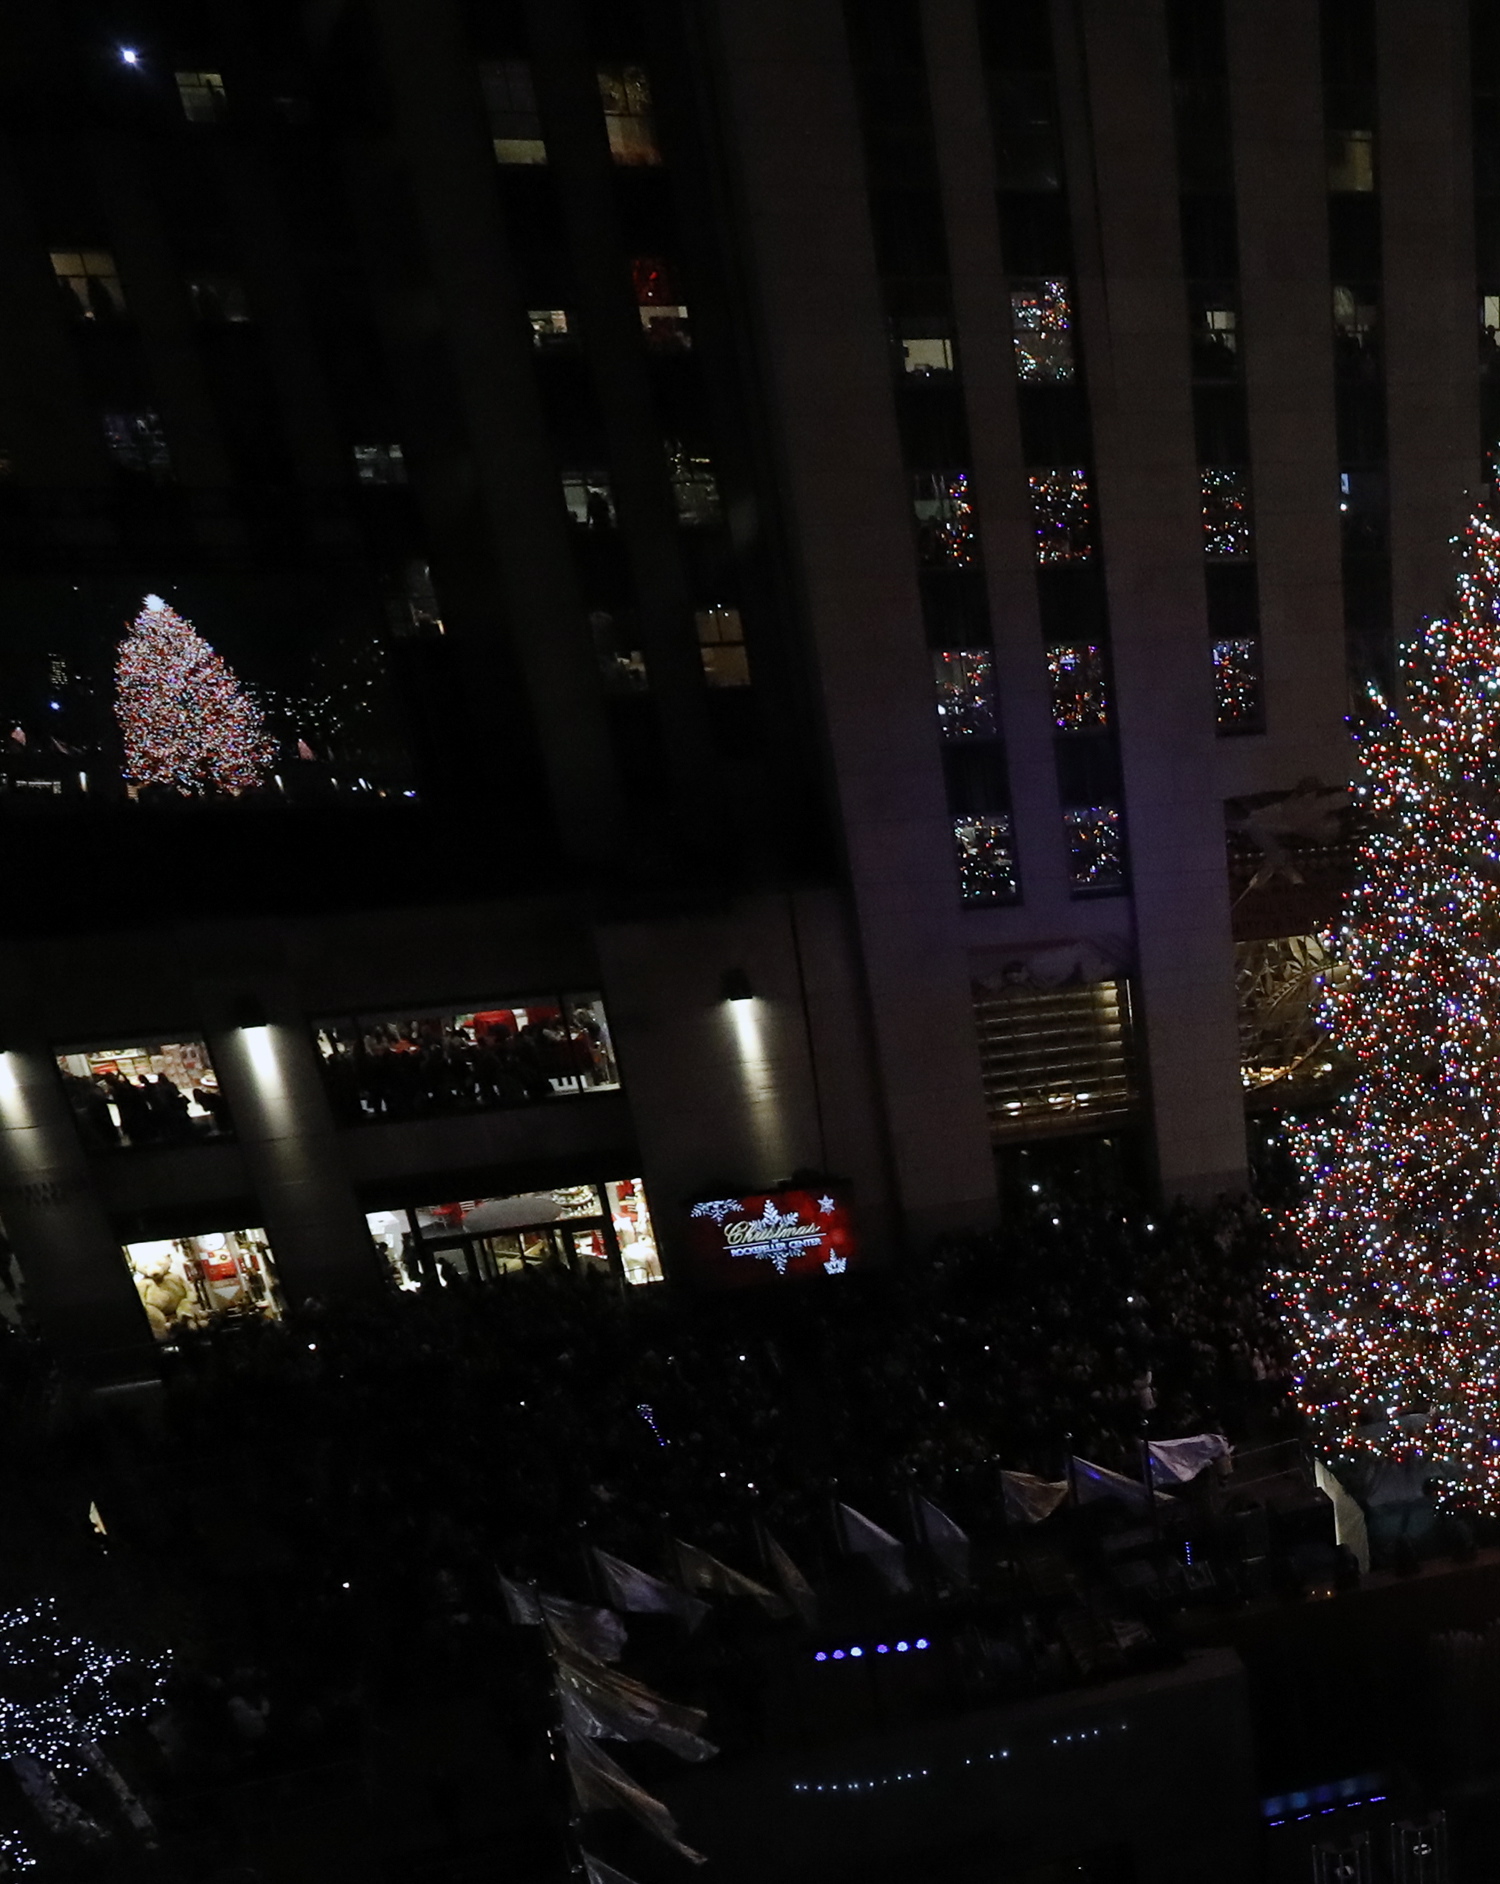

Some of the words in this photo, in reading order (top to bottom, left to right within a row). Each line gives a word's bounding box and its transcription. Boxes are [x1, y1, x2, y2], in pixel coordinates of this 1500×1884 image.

[724, 1221, 821, 1244] Christmas
[731, 1243, 786, 1257] ROCKEFELLER
[788, 1238, 822, 1248] CENTER
